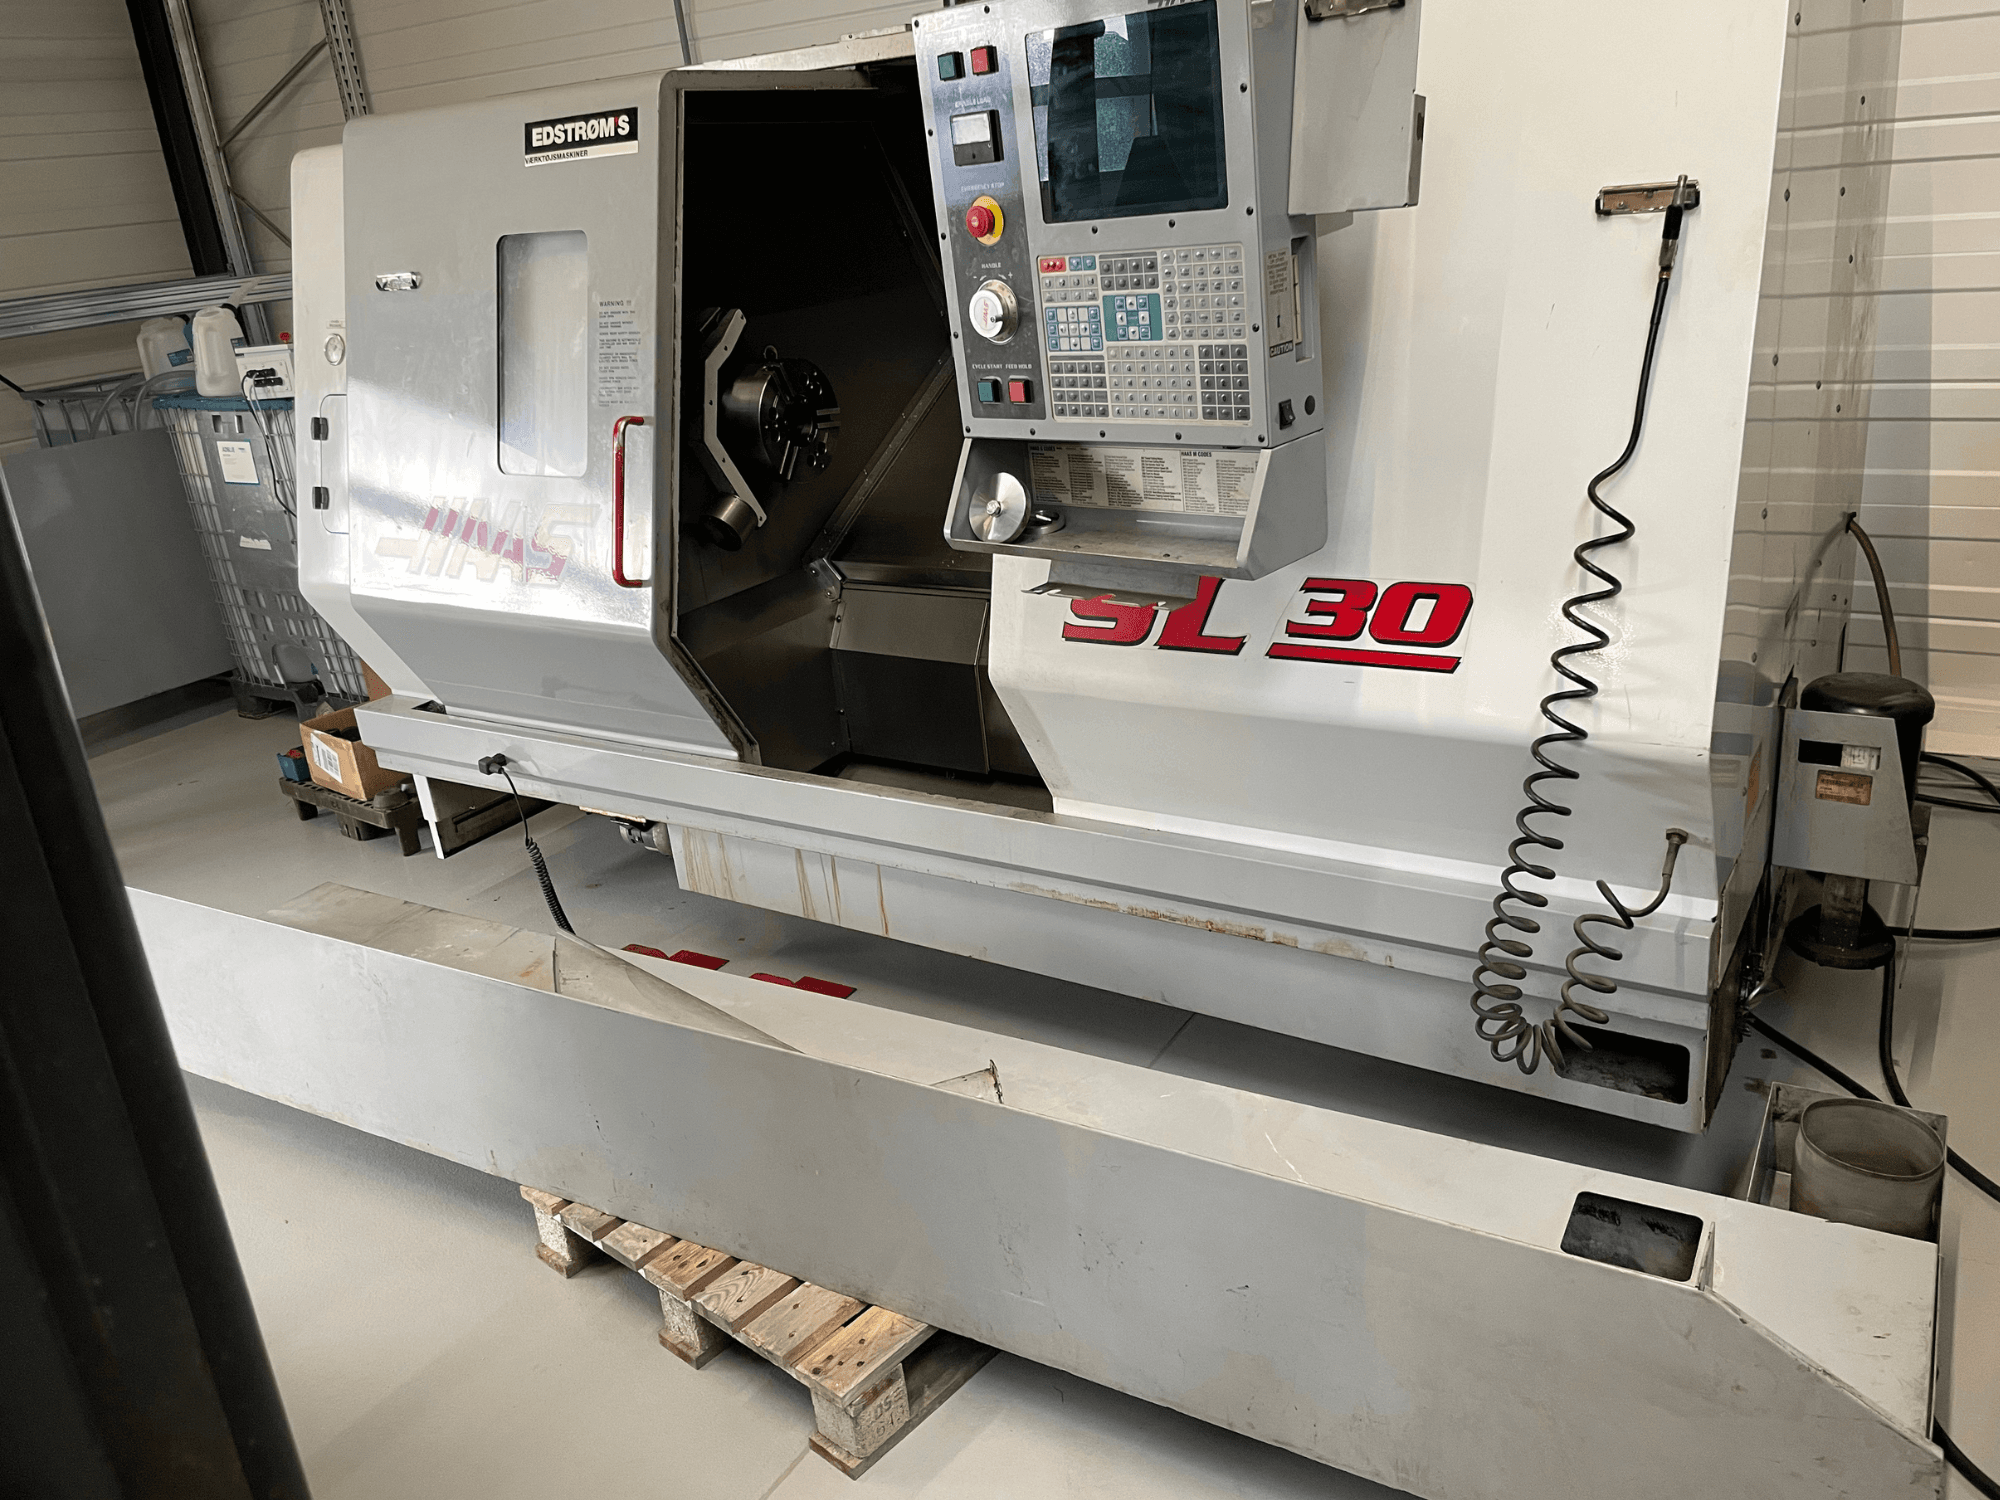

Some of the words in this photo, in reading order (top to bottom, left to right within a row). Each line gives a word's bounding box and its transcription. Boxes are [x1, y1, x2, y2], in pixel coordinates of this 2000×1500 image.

[531, 115, 630, 147] EDSTRØM'S
[1270, 341, 1293, 357] CAUTION
[1285, 577, 1474, 648] 30
